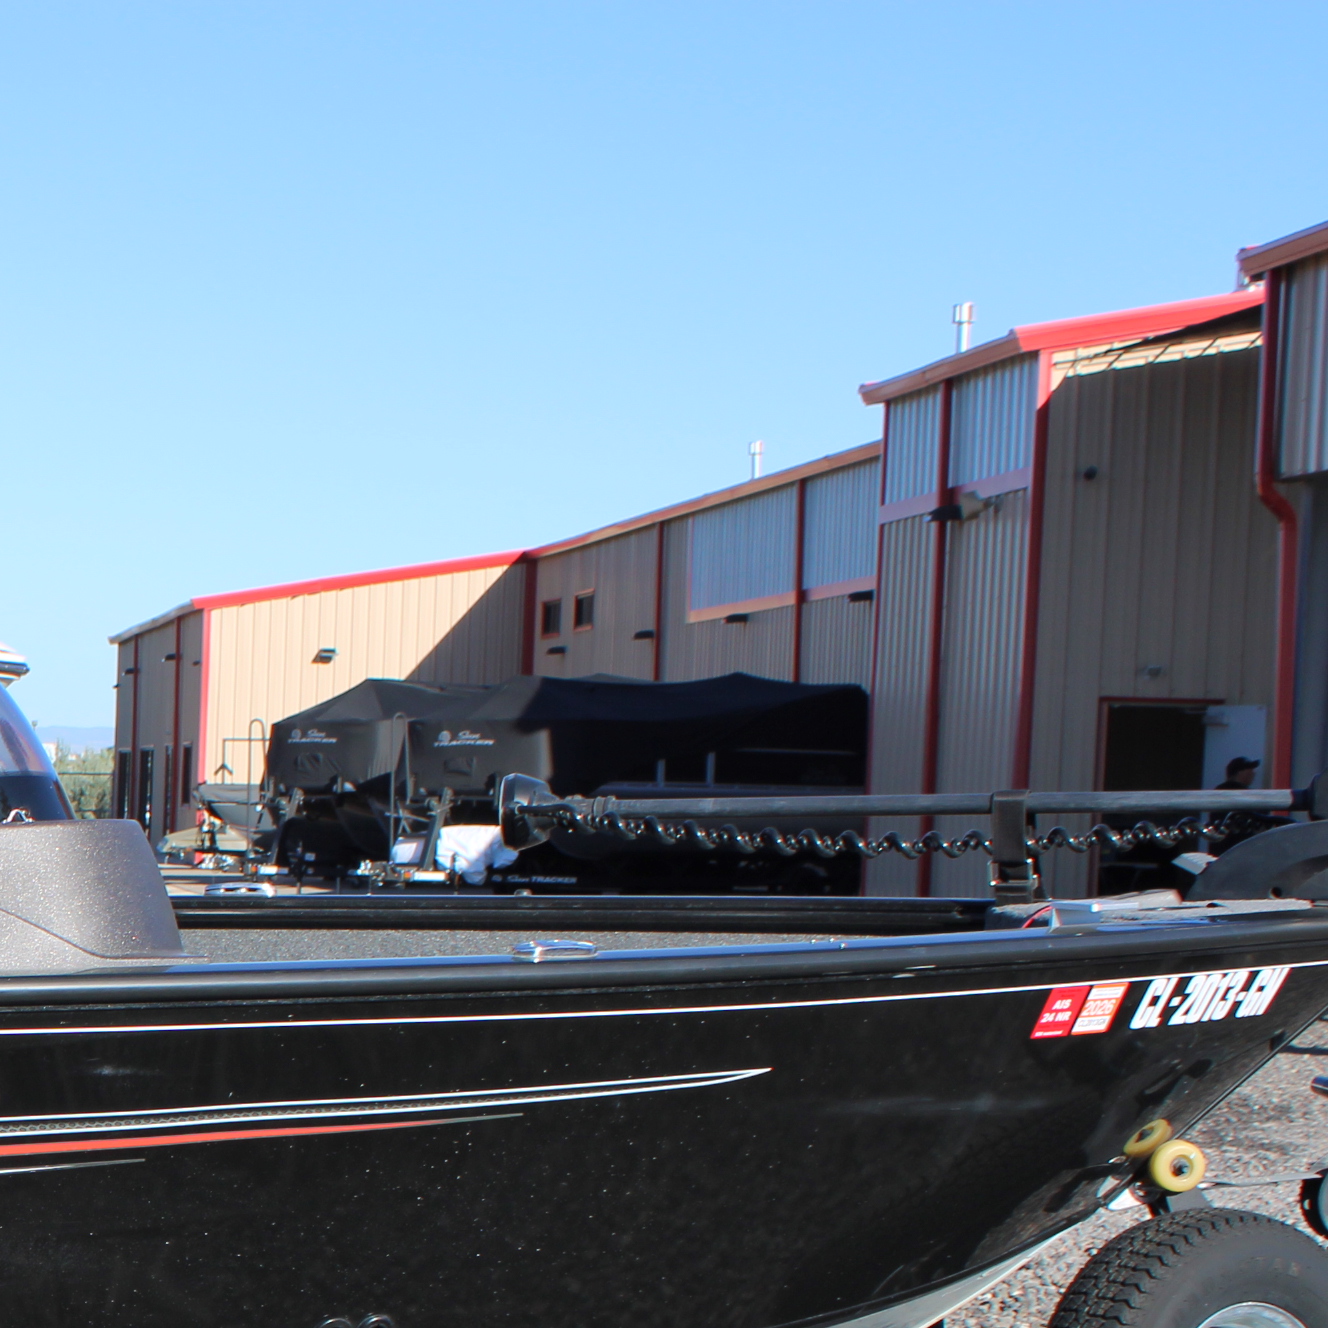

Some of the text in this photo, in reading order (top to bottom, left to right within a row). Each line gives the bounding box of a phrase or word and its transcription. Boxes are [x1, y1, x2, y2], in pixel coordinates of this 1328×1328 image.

[1052, 999, 1072, 1010] AIS
[1081, 999, 1116, 1016] 2026
[1040, 1012, 1054, 1023] 24
